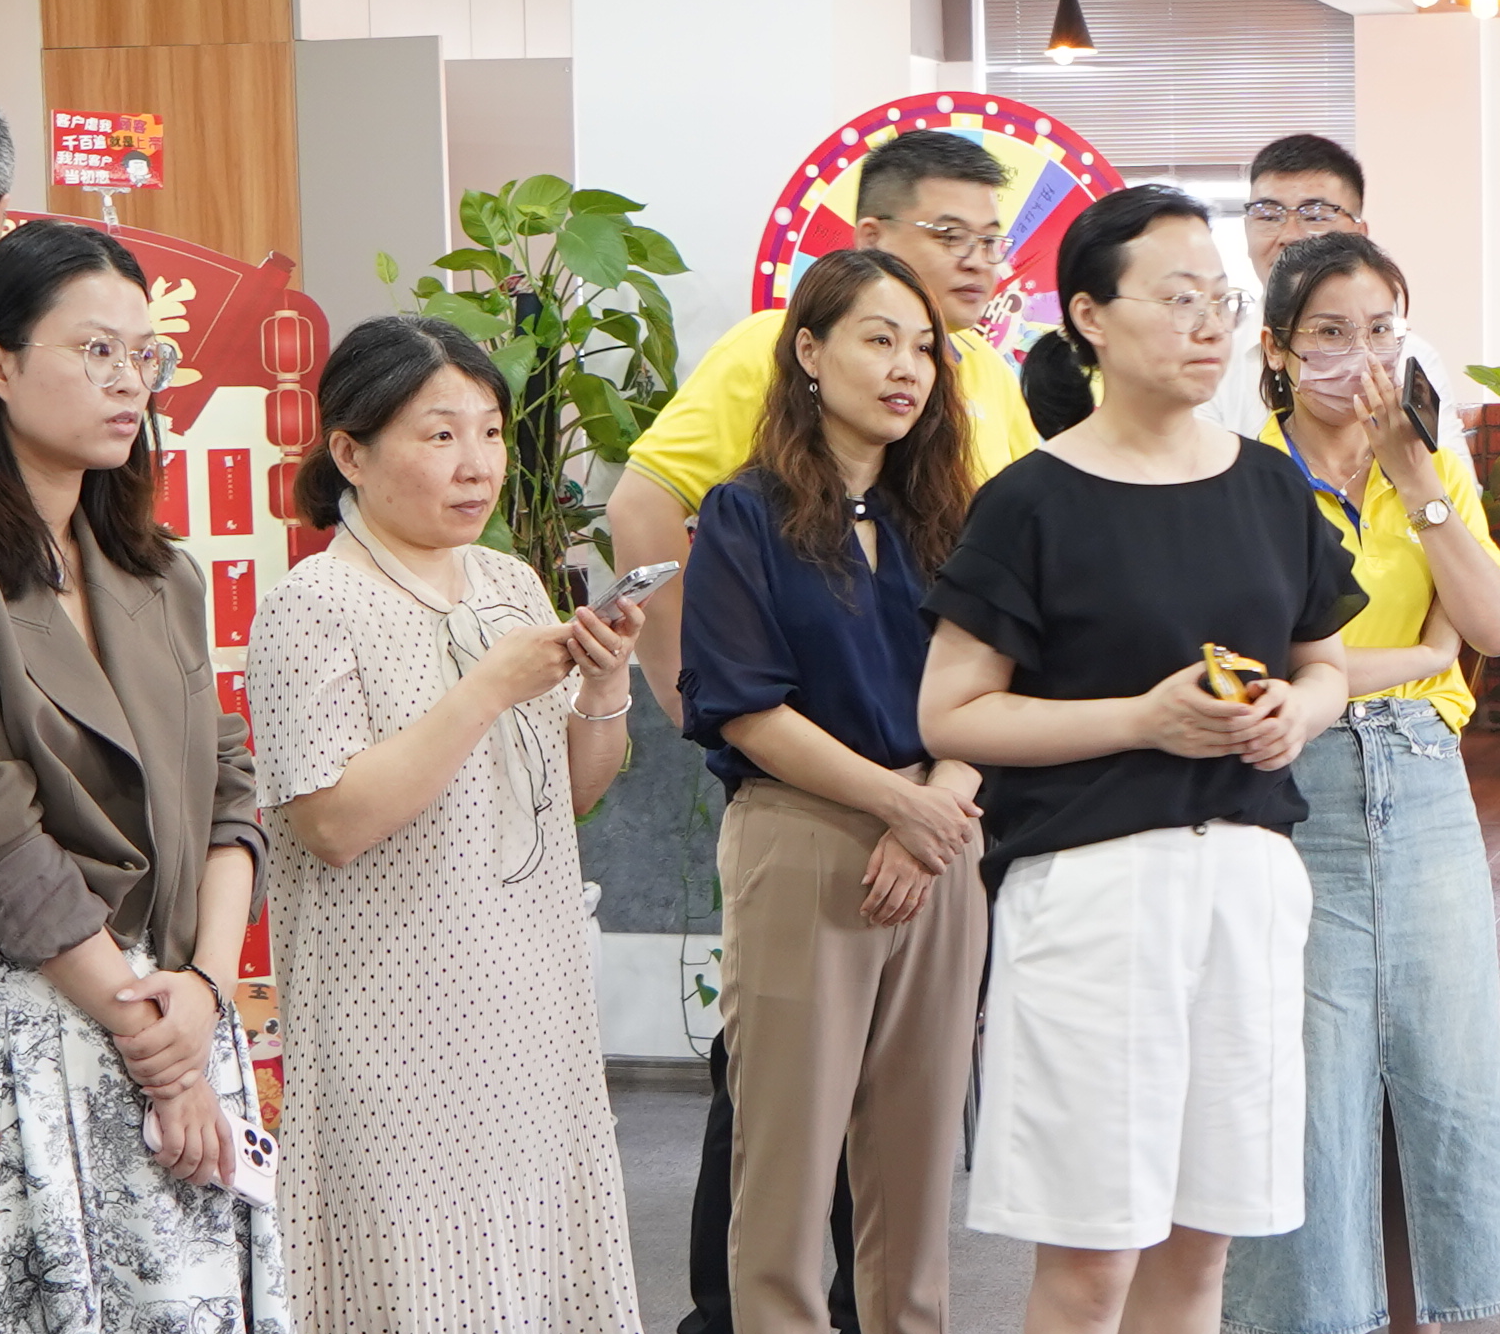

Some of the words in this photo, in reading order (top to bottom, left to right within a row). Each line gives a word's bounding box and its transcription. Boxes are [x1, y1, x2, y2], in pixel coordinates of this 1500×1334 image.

[62, 134, 107, 151] 千百遍
[56, 151, 113, 167] 我把客户
